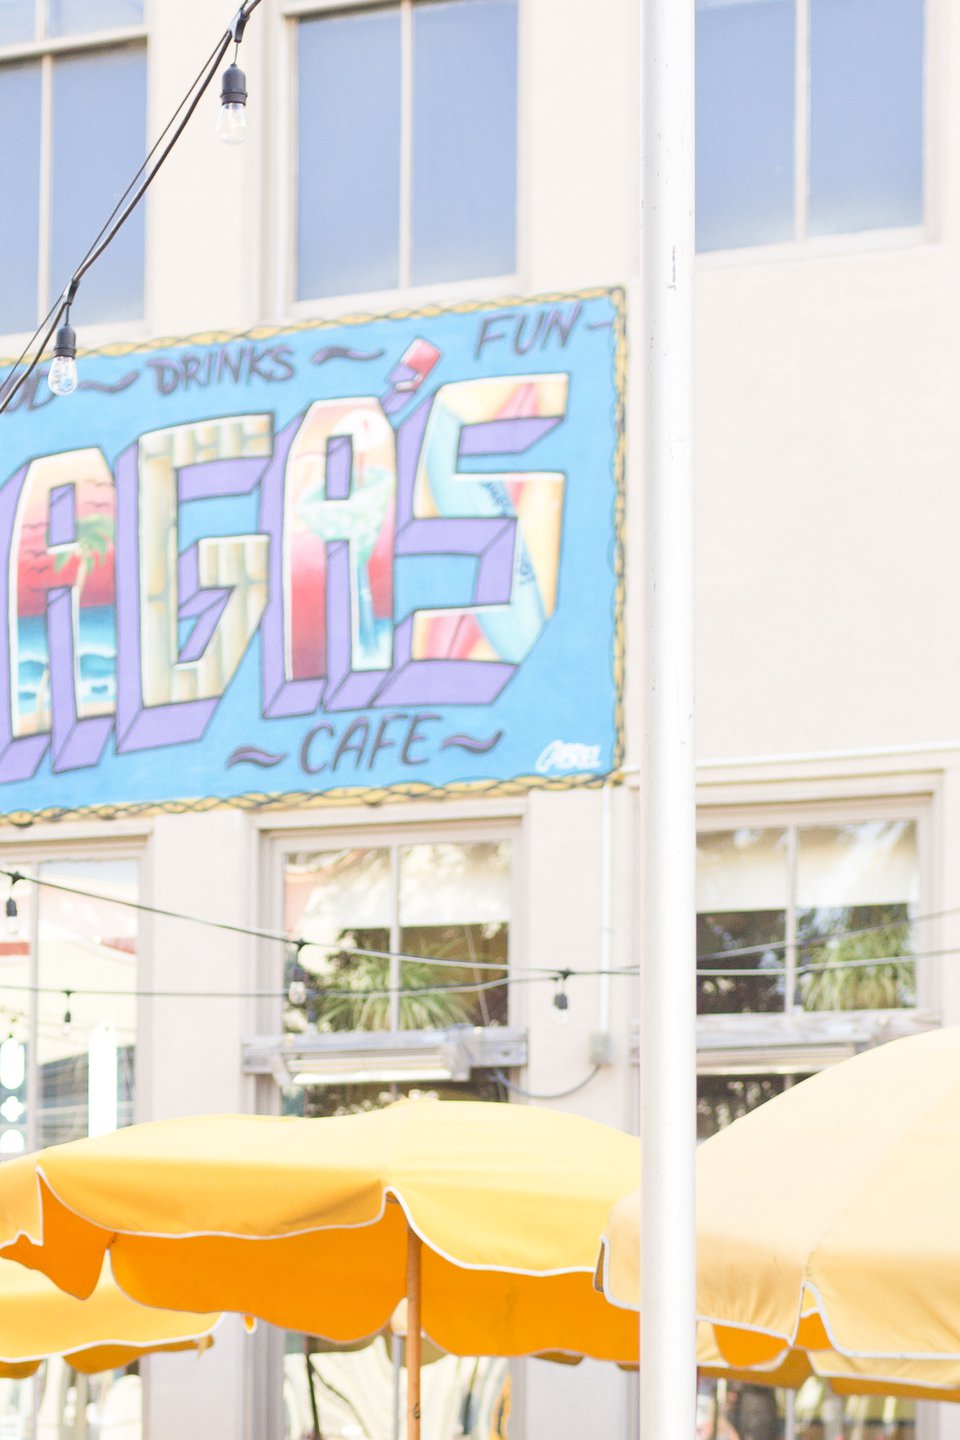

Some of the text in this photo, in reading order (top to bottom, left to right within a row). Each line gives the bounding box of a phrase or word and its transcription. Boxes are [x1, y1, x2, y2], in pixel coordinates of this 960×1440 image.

[146, 344, 295, 396] DRINKS
[474, 302, 582, 361] FUN
[300, 712, 443, 775] CAFE
